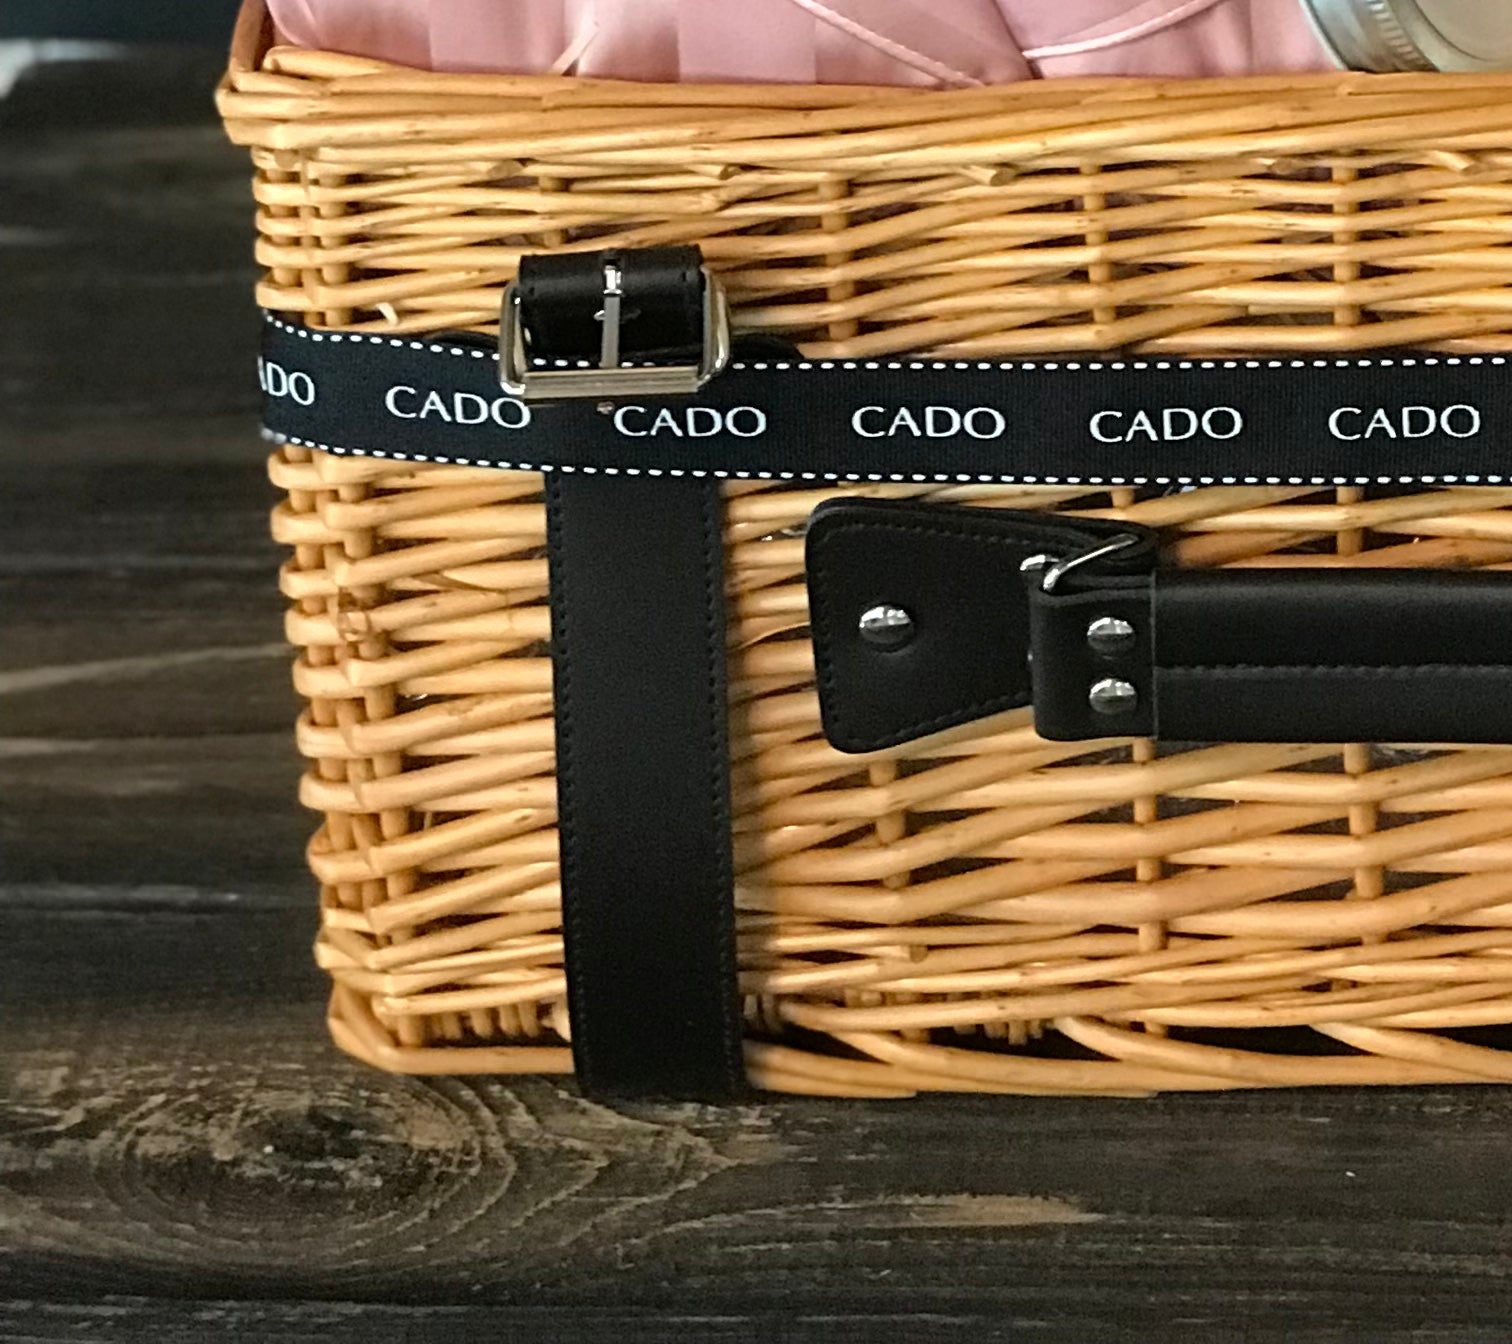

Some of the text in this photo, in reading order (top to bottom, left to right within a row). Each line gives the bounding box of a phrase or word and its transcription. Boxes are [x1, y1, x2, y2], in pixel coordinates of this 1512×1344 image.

[257, 354, 316, 406] DO
[385, 385, 532, 429] CADO
[613, 405, 767, 437] CADO
[851, 406, 1006, 439] CADO
[1089, 406, 1243, 443] CADO
[1328, 404, 1481, 441] CADO
